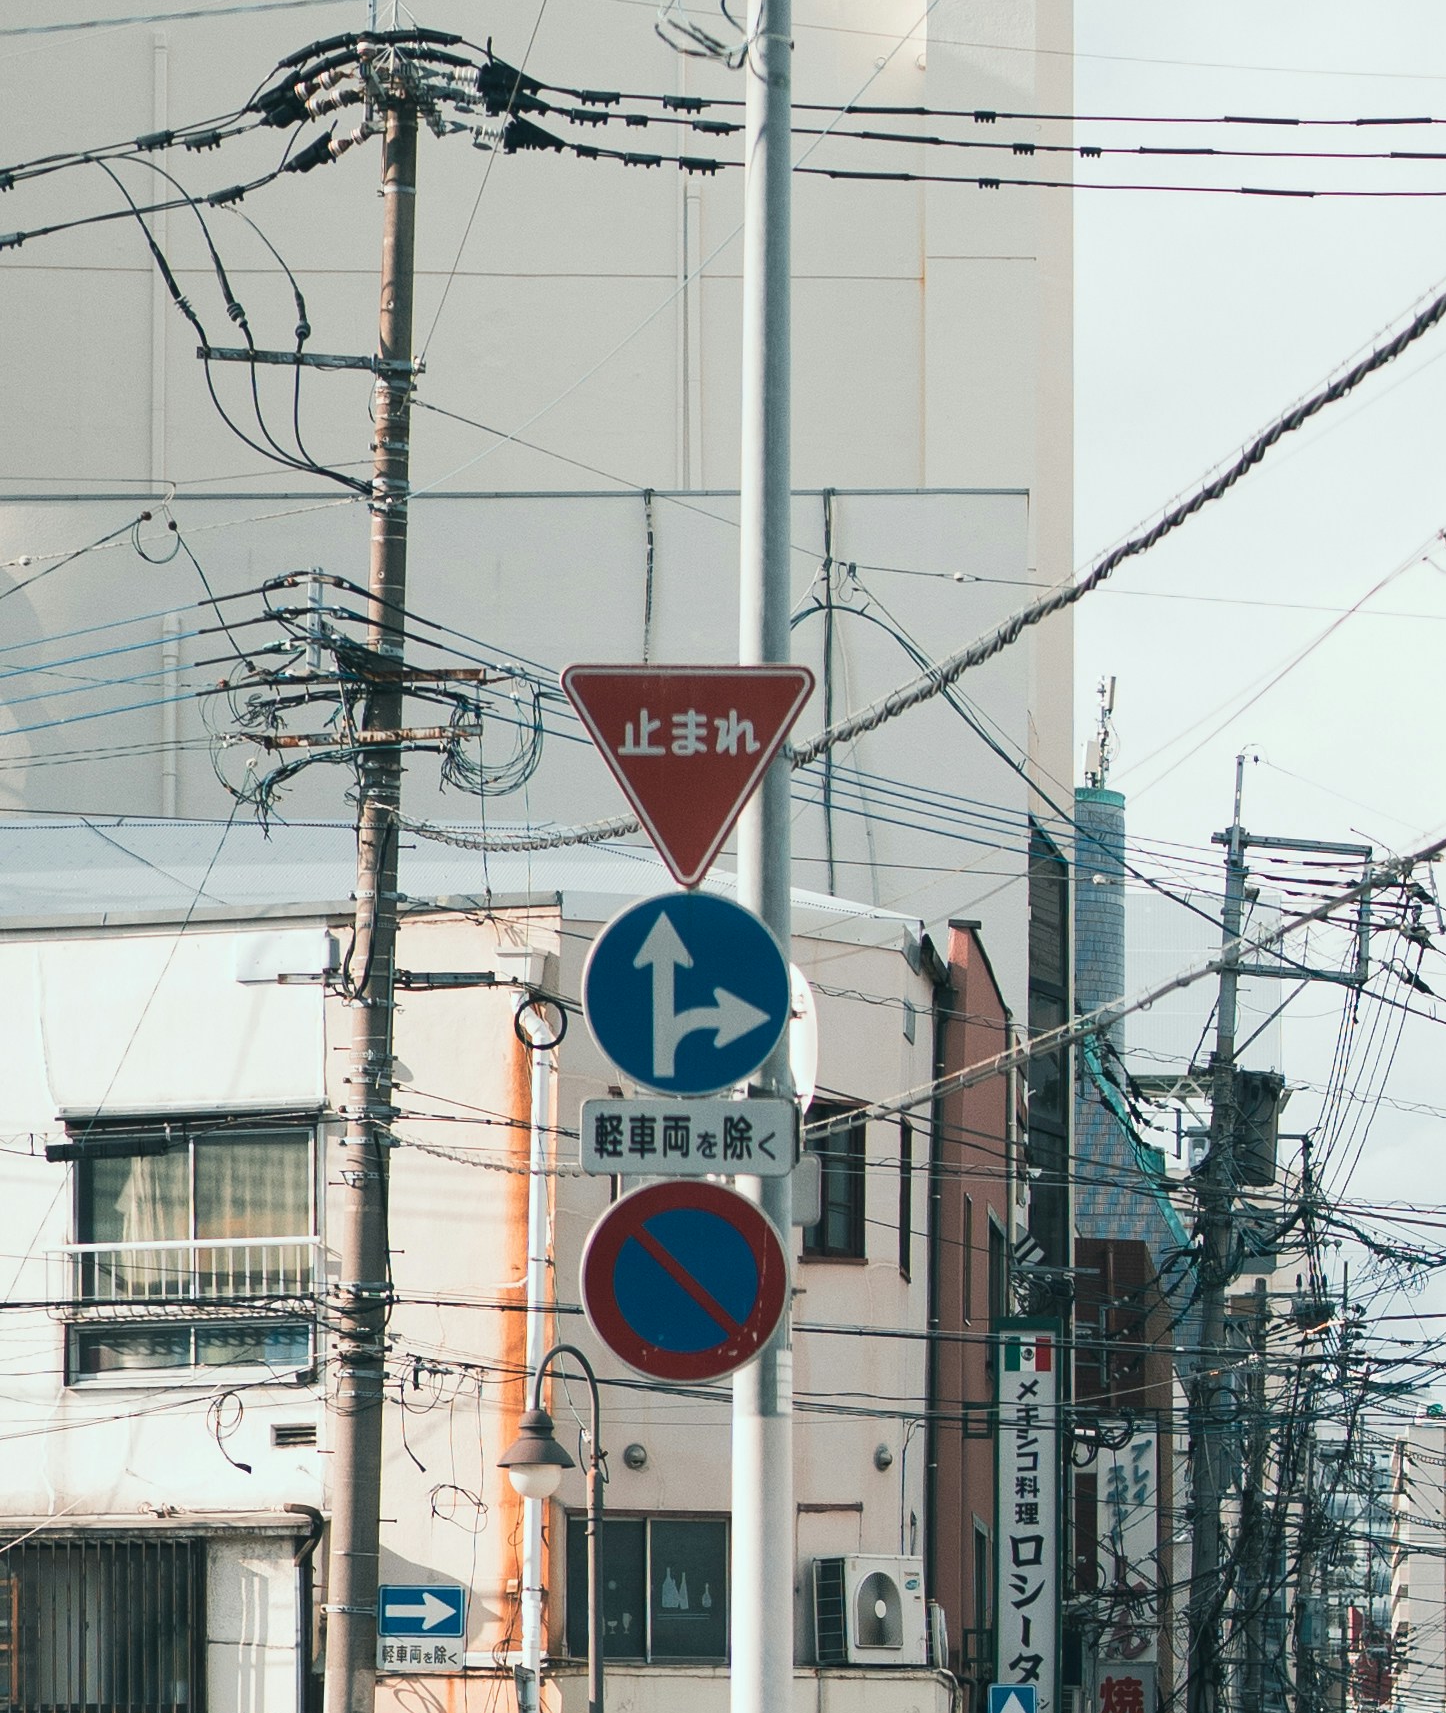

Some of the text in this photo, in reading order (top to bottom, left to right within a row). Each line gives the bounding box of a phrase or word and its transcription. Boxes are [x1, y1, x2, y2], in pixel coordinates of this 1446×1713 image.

[618, 708, 760, 756] 止まれ
[595, 1113, 776, 1161] 軽車両を除く
[382, 1645, 457, 1664] 軽車両を除く
